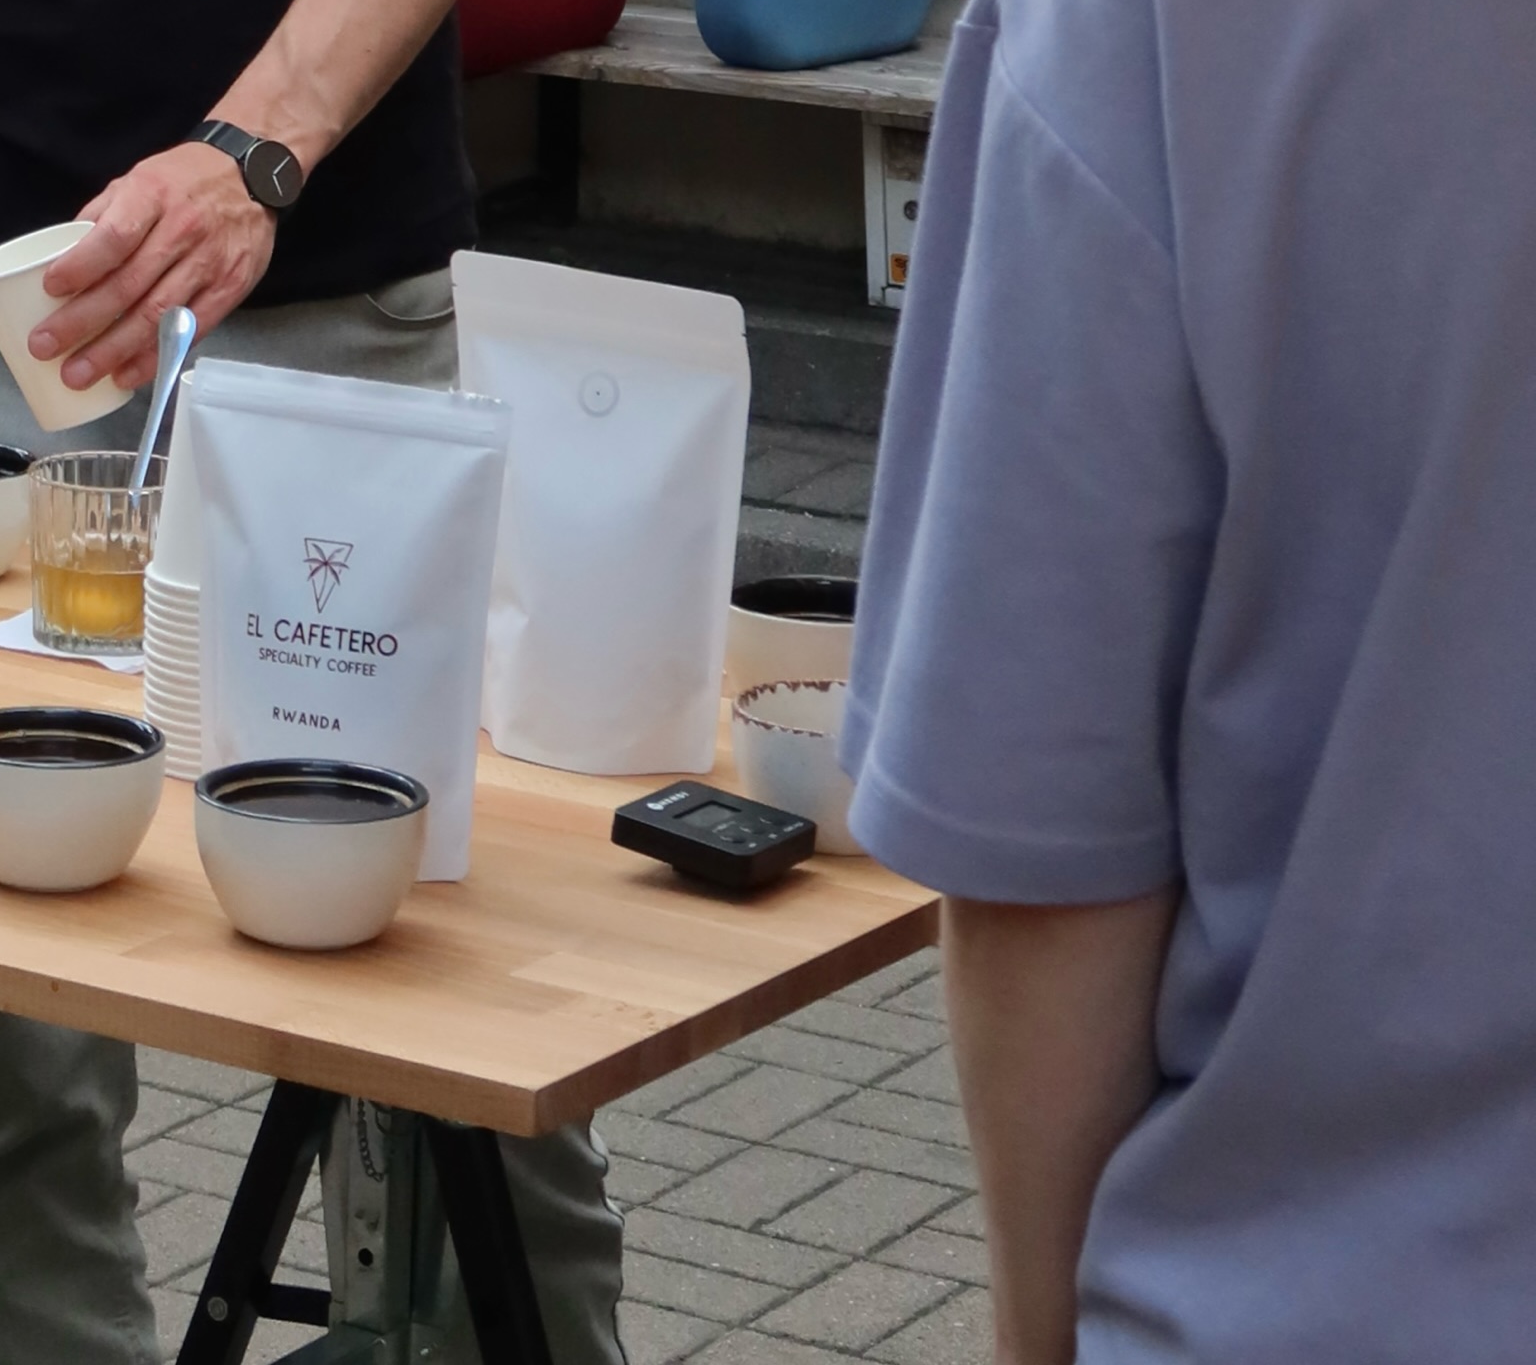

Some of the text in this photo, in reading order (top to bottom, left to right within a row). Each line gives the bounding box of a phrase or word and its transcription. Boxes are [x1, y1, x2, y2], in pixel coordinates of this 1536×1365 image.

[246, 613, 399, 657] EL CAFETERO
[258, 647, 378, 677] SPECIALTY COFFEE
[272, 705, 342, 732] RWANDA
